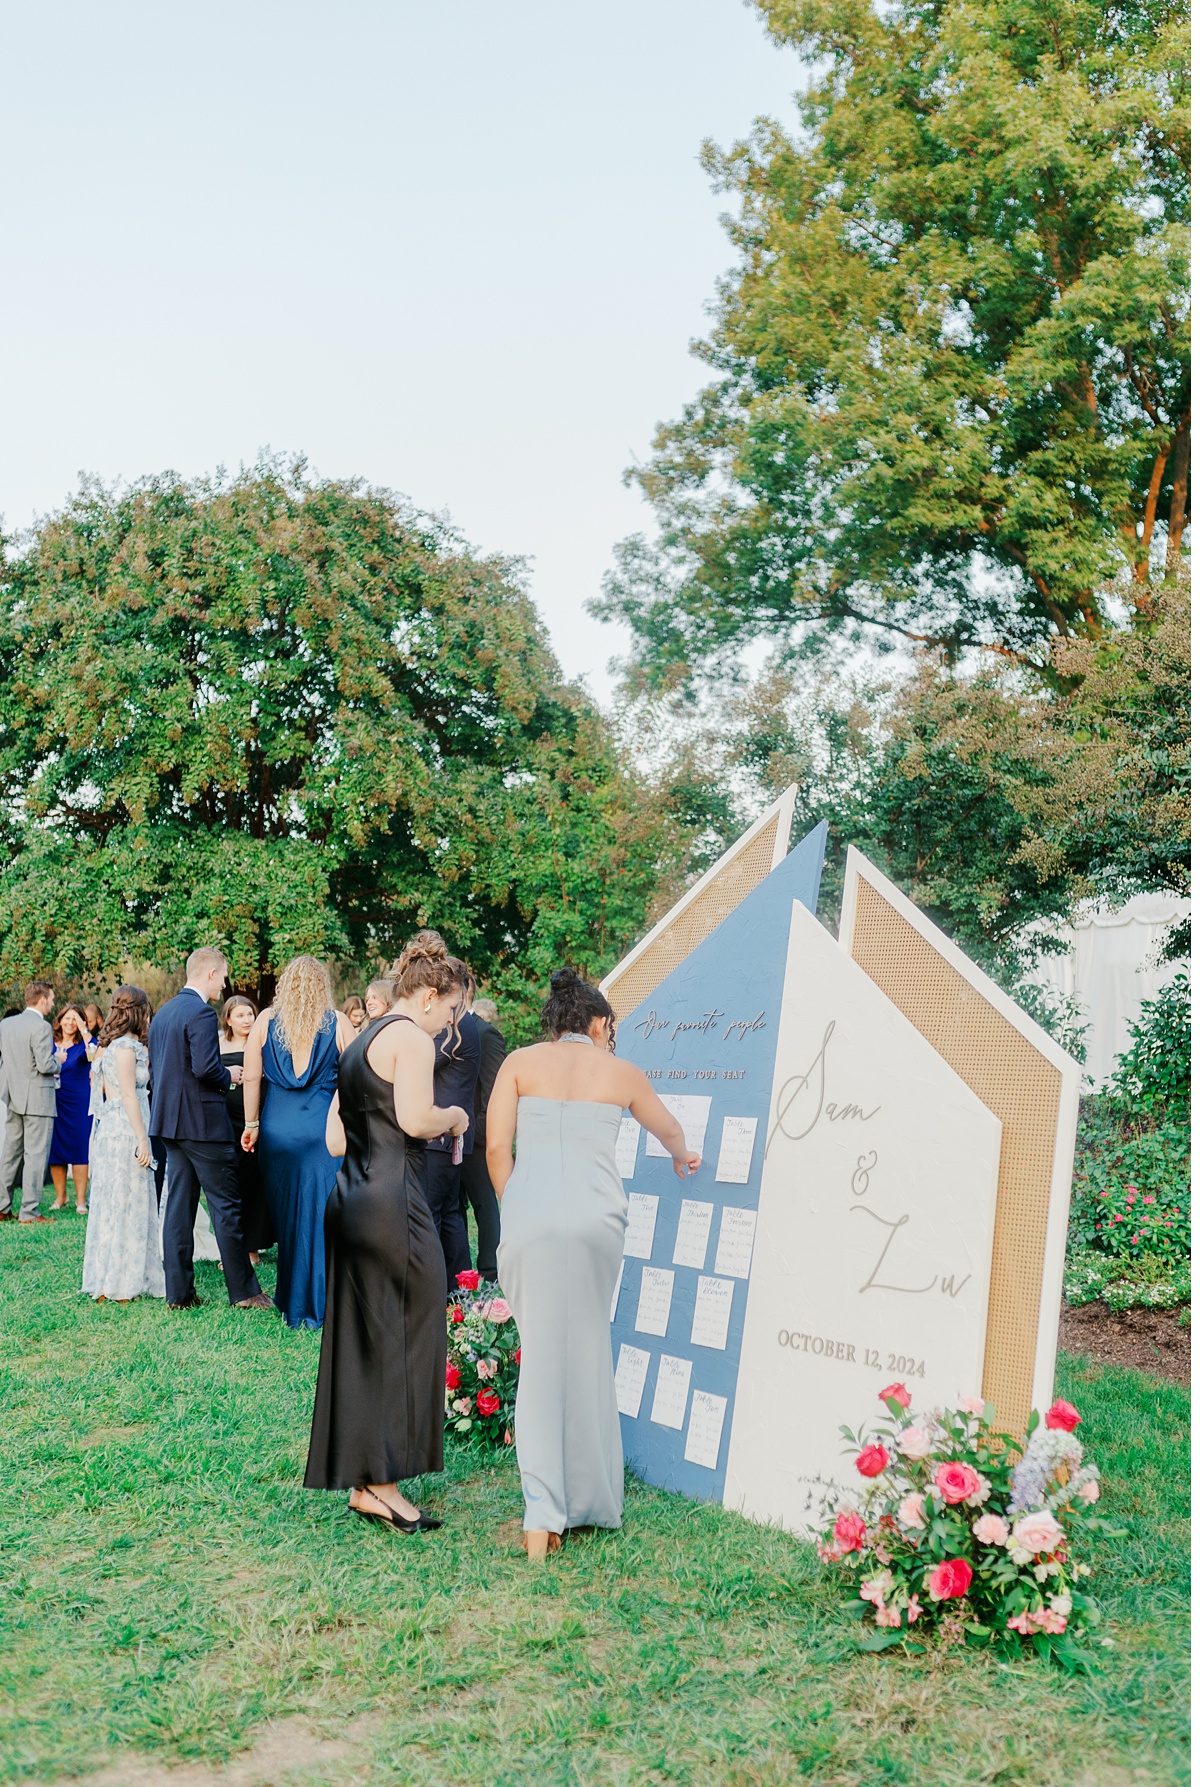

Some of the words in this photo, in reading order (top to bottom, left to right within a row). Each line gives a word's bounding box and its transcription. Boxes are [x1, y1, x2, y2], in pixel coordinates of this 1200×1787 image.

[633, 1009, 670, 1039] Our
[722, 1010, 766, 1041] people
[667, 1069, 687, 1080] FIND
[693, 1070, 717, 1080] YOUR
[722, 1070, 745, 1080] SEAT
[764, 1019, 882, 1160] Sam
[851, 1150, 878, 1196] &
[777, 1329, 857, 1363] OCTOBER
[862, 1348, 883, 1372] 12,
[886, 1353, 926, 1379] 2024
